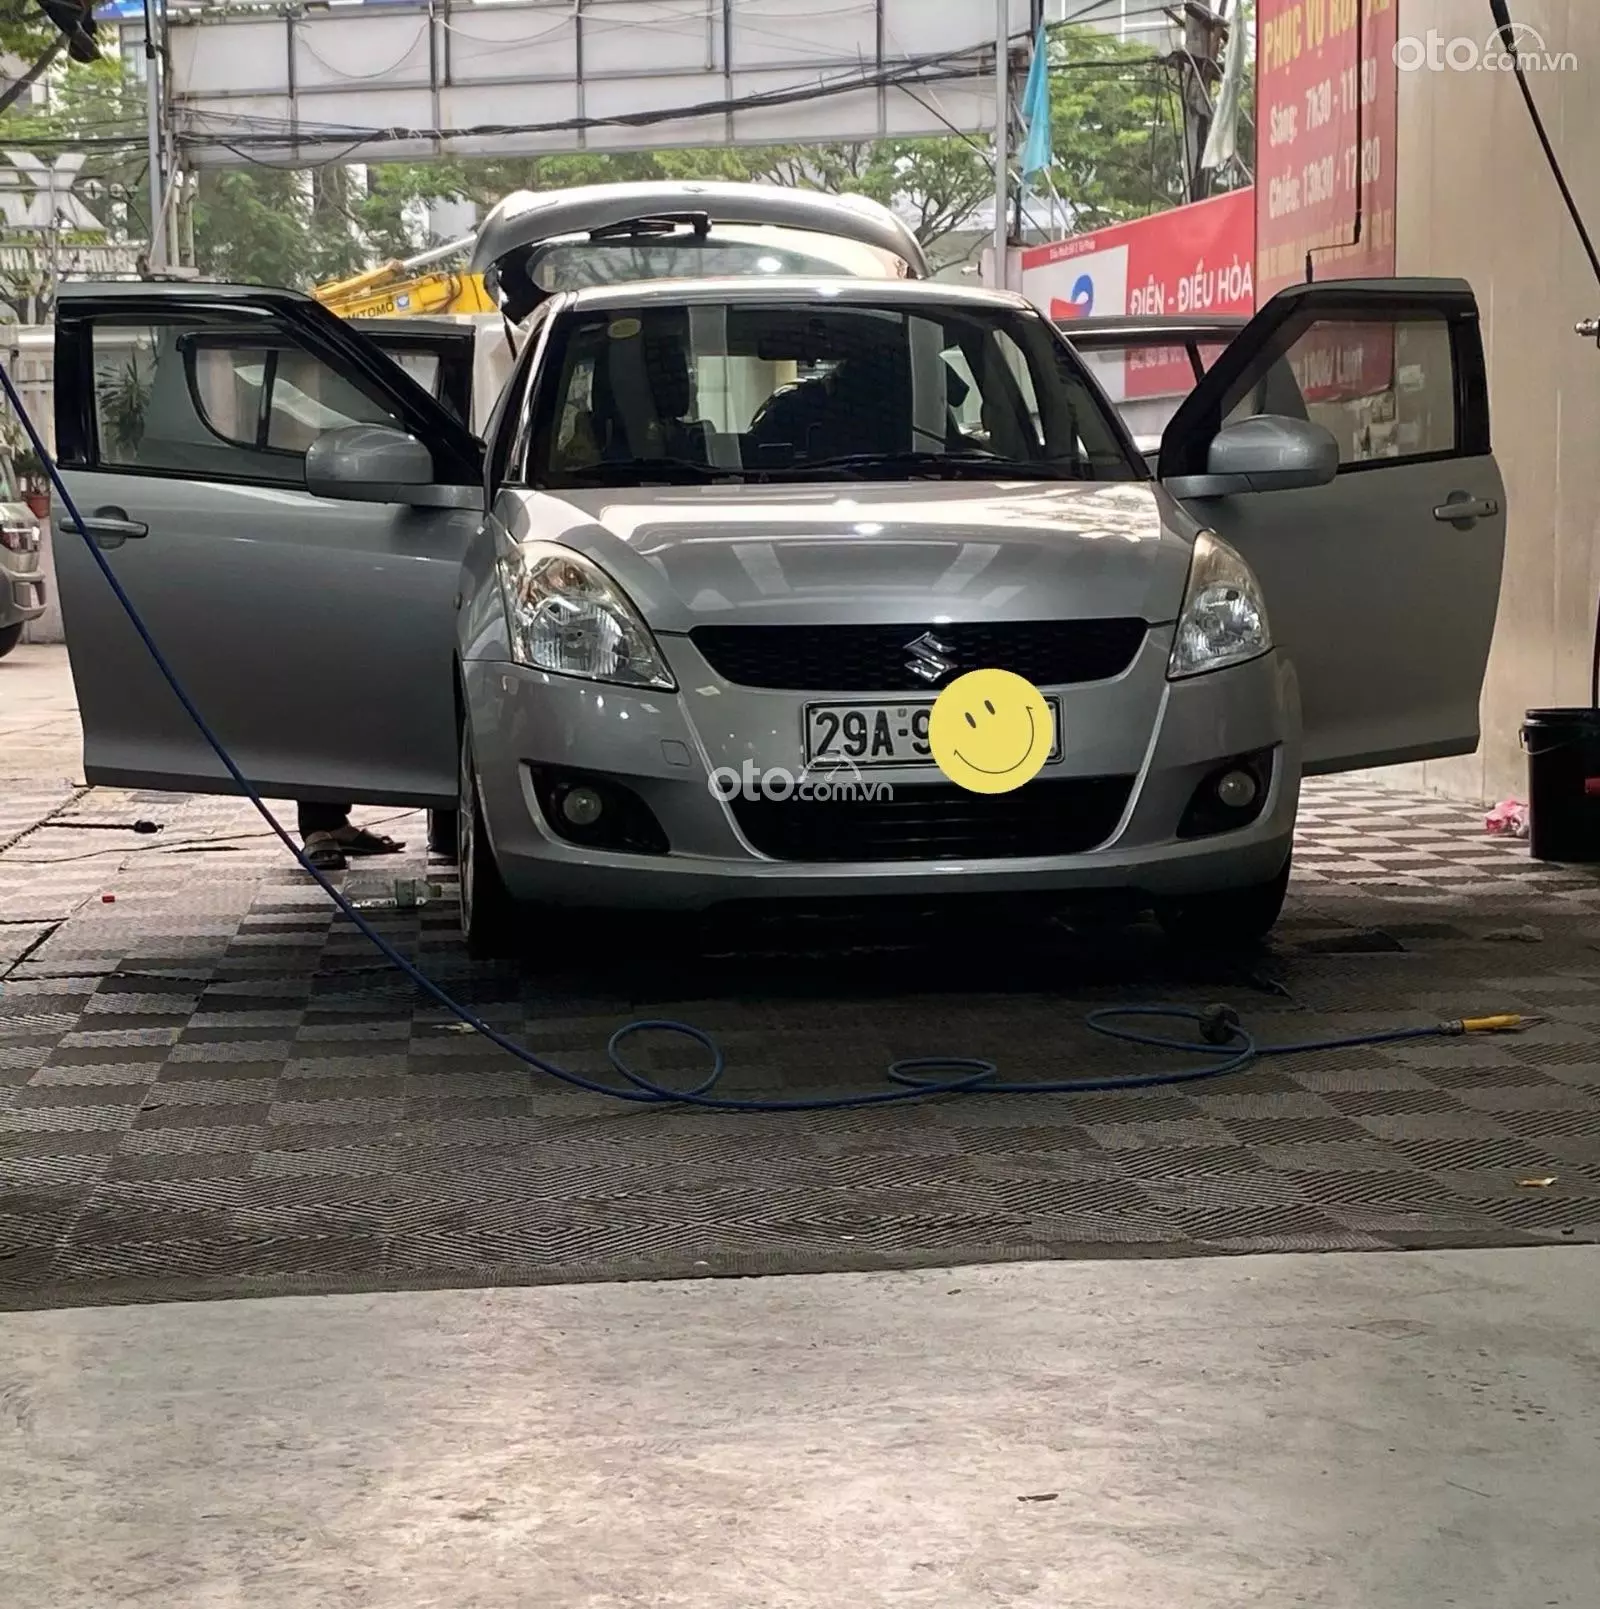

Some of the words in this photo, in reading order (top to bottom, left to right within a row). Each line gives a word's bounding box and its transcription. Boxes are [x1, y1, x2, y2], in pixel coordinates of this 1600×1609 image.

[1264, 4, 1301, 76] PHỤC
[1340, 57, 1377, 114] 1130
[1217, 253, 1253, 303] HÒA
